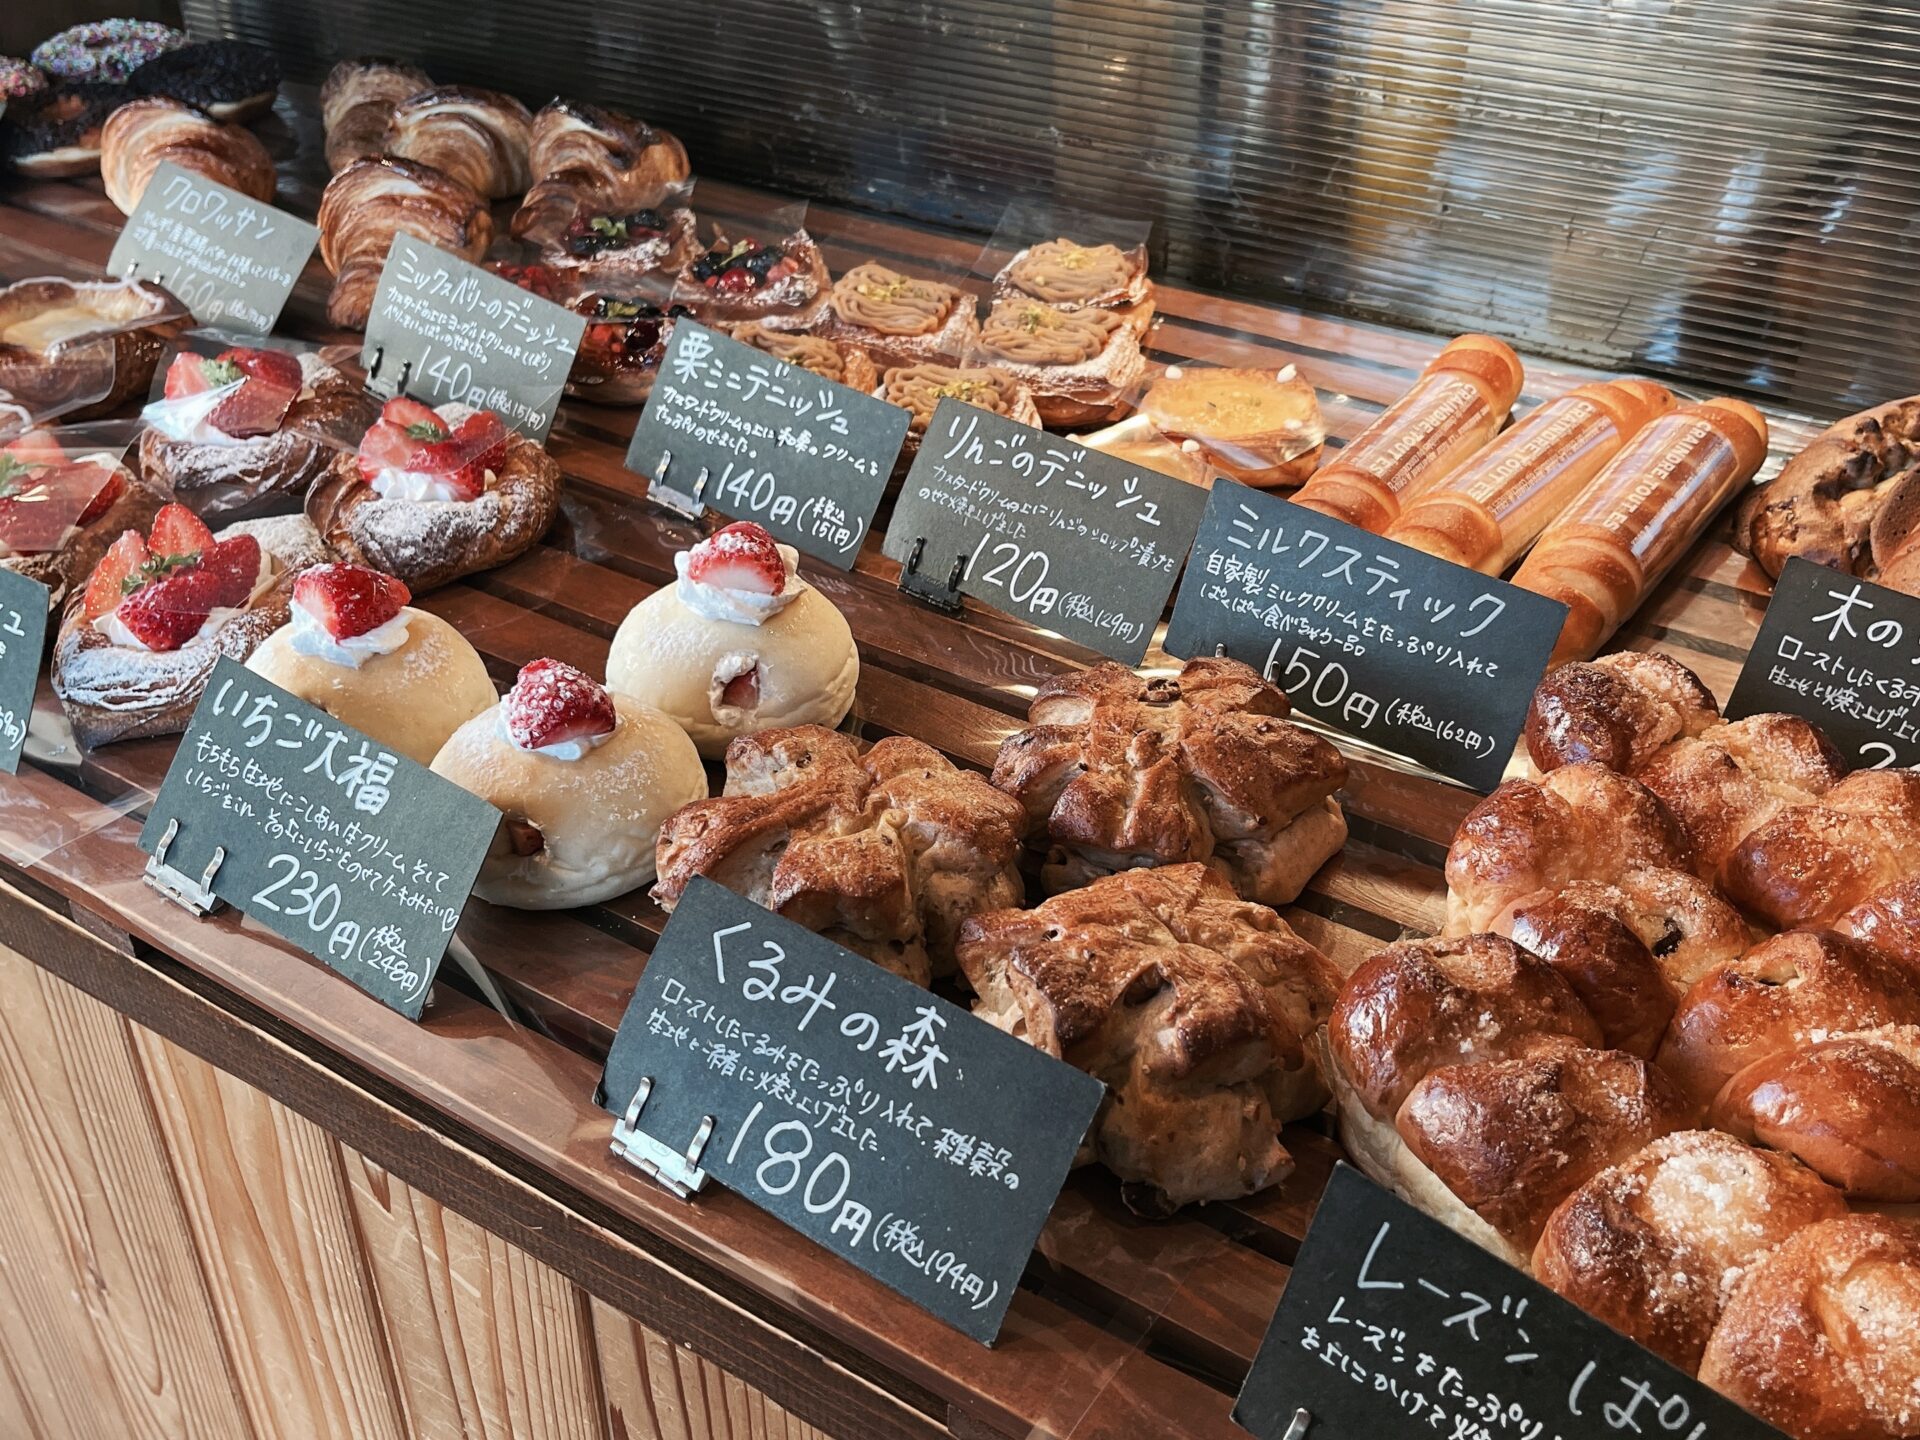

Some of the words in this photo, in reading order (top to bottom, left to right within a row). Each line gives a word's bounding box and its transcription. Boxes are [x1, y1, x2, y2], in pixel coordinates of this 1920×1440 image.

[163, 176, 275, 240] クロワッサン
[397, 248, 576, 355] ミックスベリーのデニッシュ
[673, 331, 850, 436] 栗ミニデニッシュ
[944, 415, 1160, 527] りんごのデニッシュ
[1227, 503, 1507, 638] ミルクスティック
[1812, 584, 1920, 668] 木の
[212, 678, 398, 815] いちご大福
[713, 921, 950, 1090] くるみの森
[1327, 1297, 1562, 1440] レーズンをたっぷり
[1357, 1222, 1706, 1440] レーズンぱ
